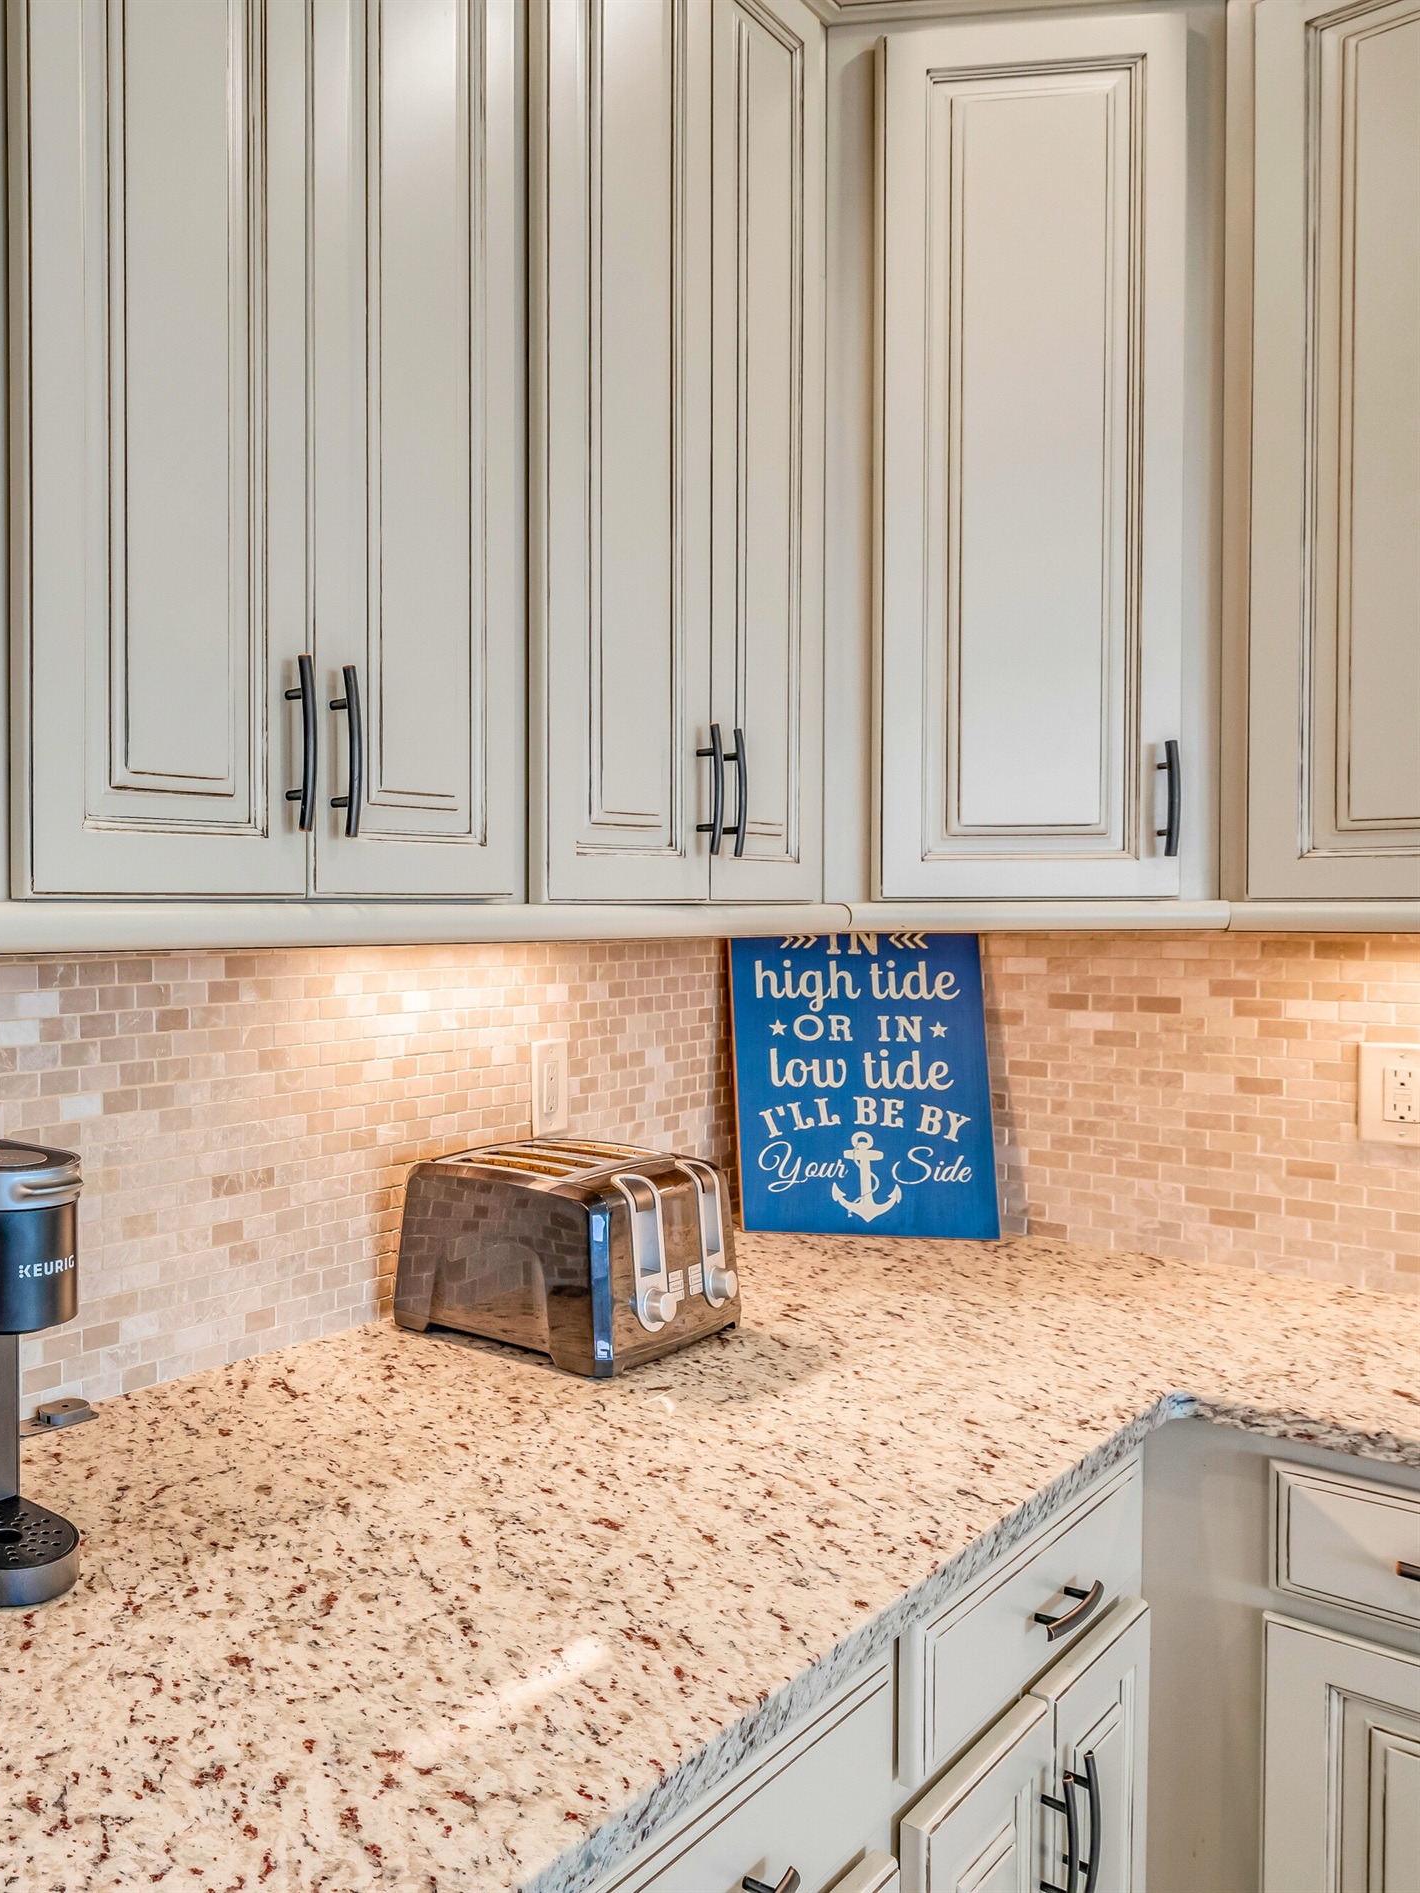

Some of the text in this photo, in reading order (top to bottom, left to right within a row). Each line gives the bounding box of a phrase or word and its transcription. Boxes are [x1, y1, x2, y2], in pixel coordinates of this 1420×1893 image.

[827, 933, 878, 956] IN
[754, 959, 960, 1012] high tide
[793, 1014, 922, 1042] OR IN
[770, 1048, 954, 1091] low tide
[759, 1096, 971, 1143] I'LL BE BY
[758, 1141, 972, 1193] Your Side
[19, 1254, 75, 1279] KEURIG
